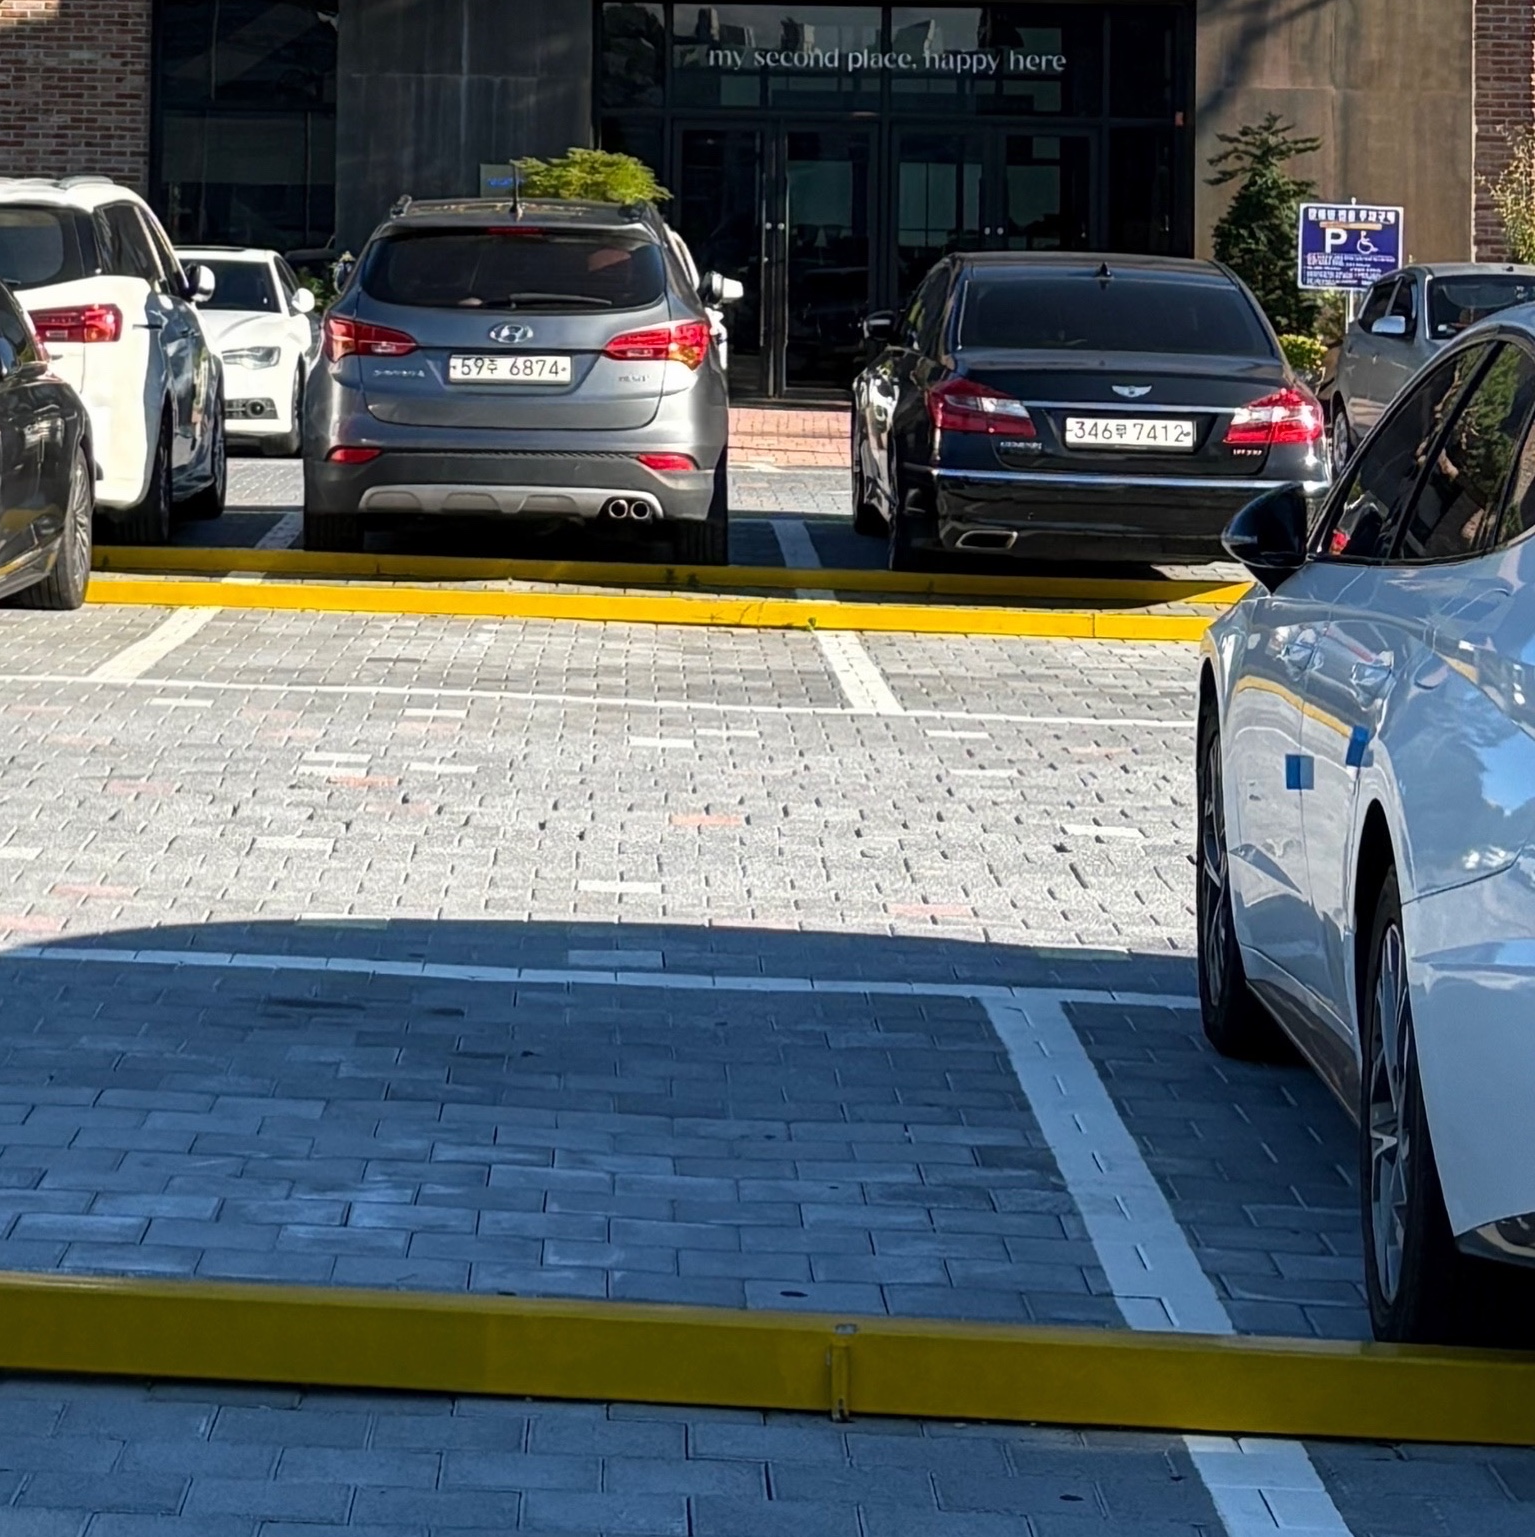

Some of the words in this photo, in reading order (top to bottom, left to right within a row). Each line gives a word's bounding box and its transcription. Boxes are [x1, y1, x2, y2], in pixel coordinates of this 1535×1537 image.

[708, 48, 748, 71] my
[753, 48, 839, 68] second
[847, 49, 917, 72] place,
[923, 49, 1001, 75] happy
[1009, 50, 1067, 72] here
[1324, 227, 1348, 254] P
[509, 357, 560, 377] 6874
[1132, 422, 1185, 443] 7412
